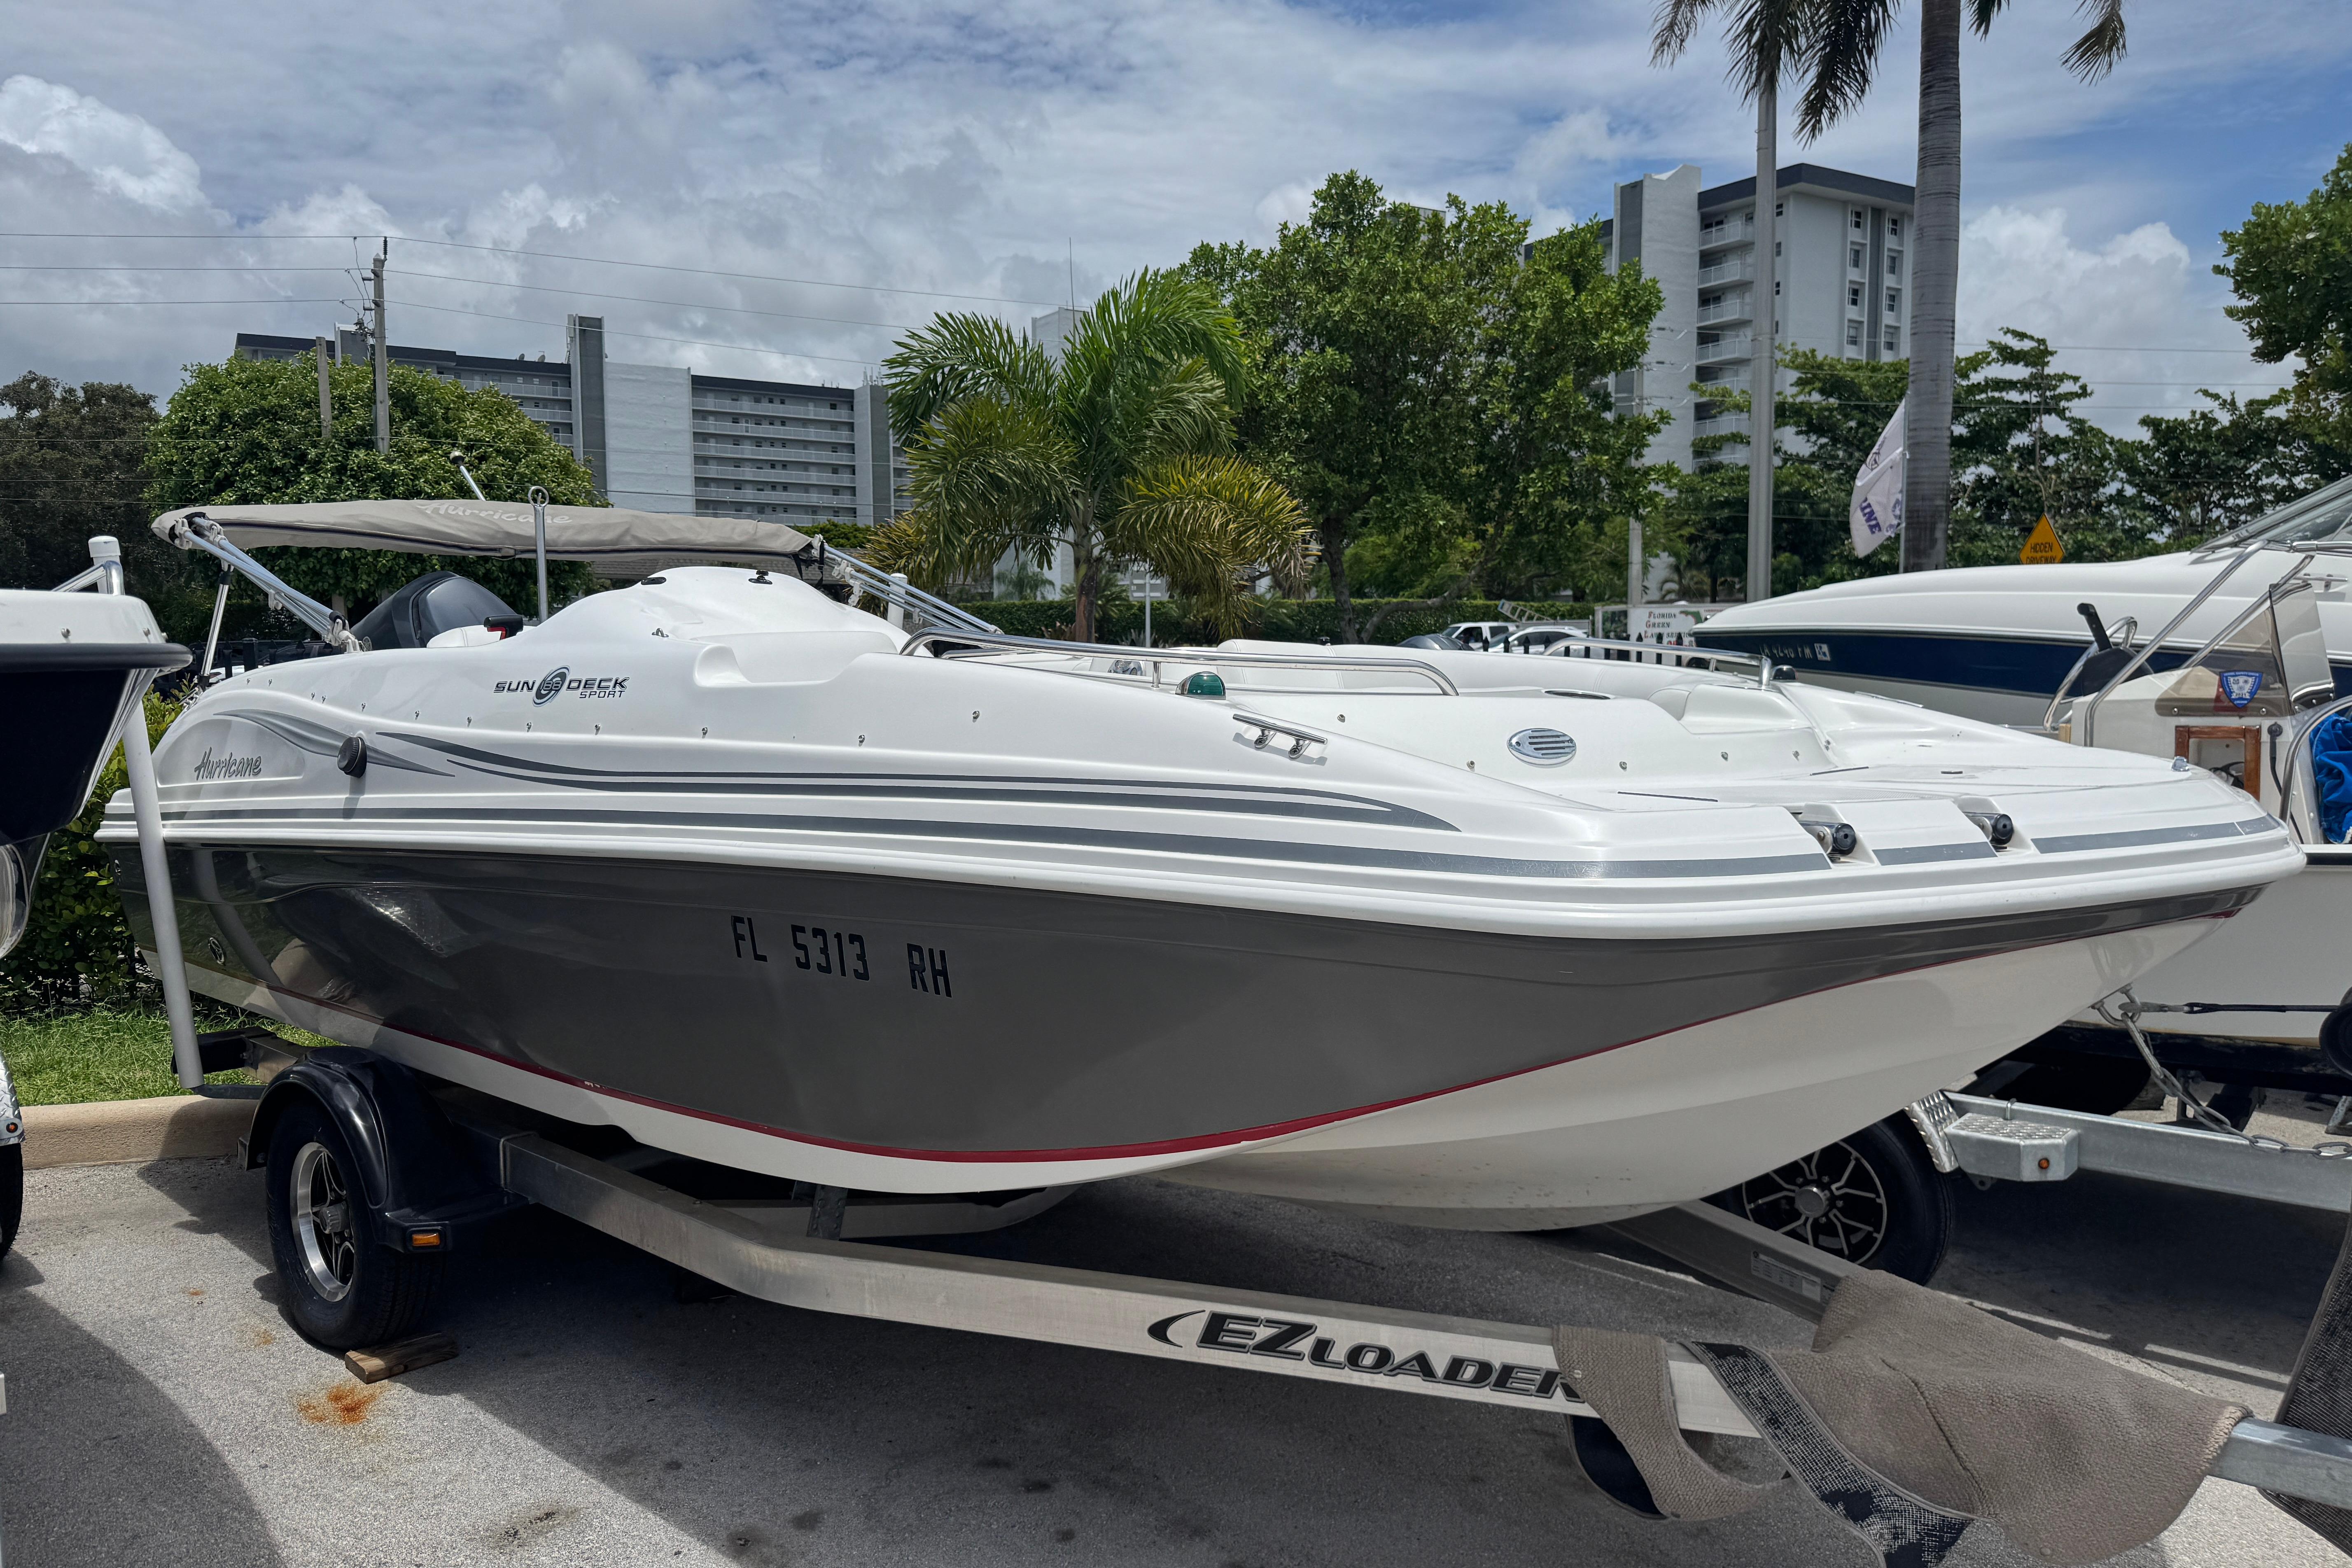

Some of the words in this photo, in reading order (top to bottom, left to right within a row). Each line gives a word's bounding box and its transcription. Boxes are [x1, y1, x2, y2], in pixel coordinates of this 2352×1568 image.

[2030, 542, 2053, 553] HIDDEN
[1646, 620, 1670, 628] GREEN
[494, 680, 536, 693] SUN
[540, 680, 562, 691] 188
[566, 677, 630, 691] DECK
[579, 690, 625, 698] SPORT
[194, 747, 262, 781] Hurricane
[731, 915, 768, 963] FL
[791, 924, 870, 982] 5313
[907, 943, 952, 998] RH
